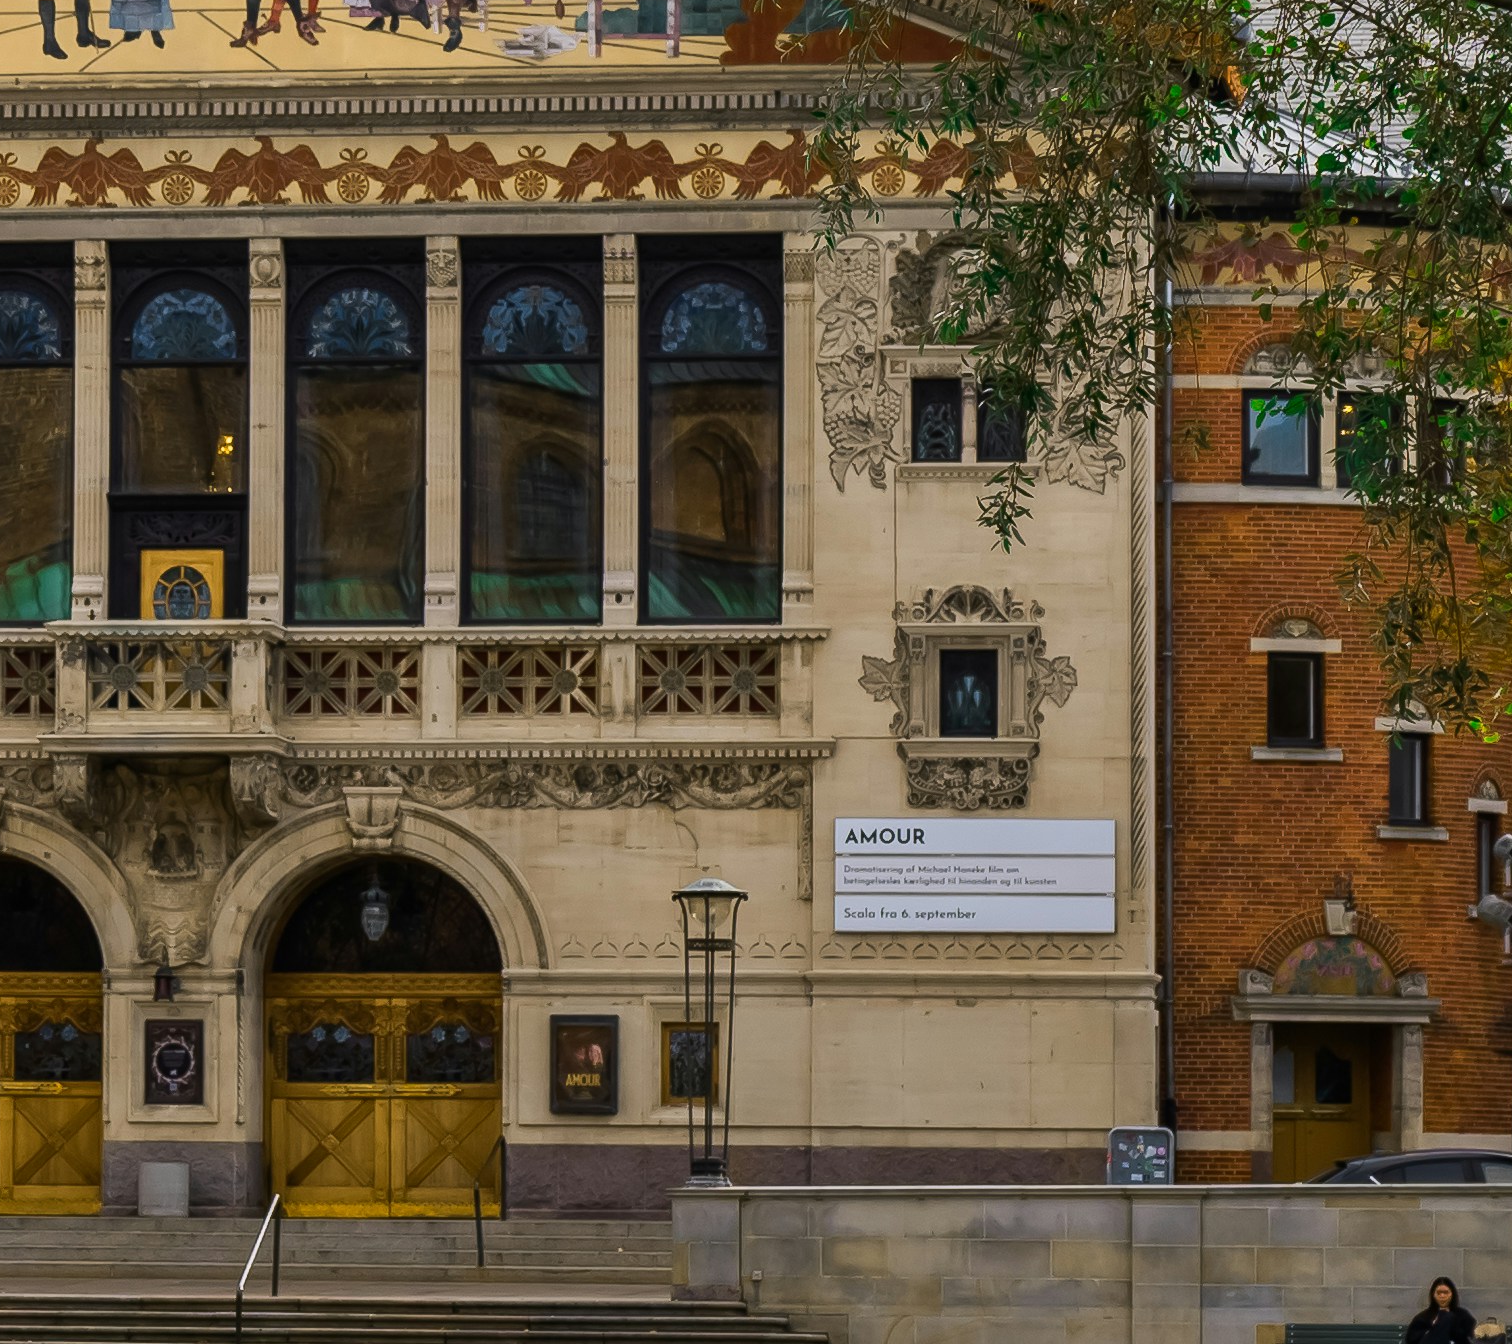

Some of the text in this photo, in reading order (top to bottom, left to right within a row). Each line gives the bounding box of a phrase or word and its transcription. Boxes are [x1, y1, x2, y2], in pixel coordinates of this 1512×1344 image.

[844, 827, 926, 845] AMOUR
[843, 864, 904, 875] Dramatisering
[905, 864, 916, 874] af
[917, 865, 952, 874] Michael
[947, 877, 957, 886] til
[999, 878, 1012, 887] og
[1013, 877, 1023, 886] til
[843, 906, 977, 921] Scala fra 6. september
[565, 1073, 601, 1087] AMOUR
